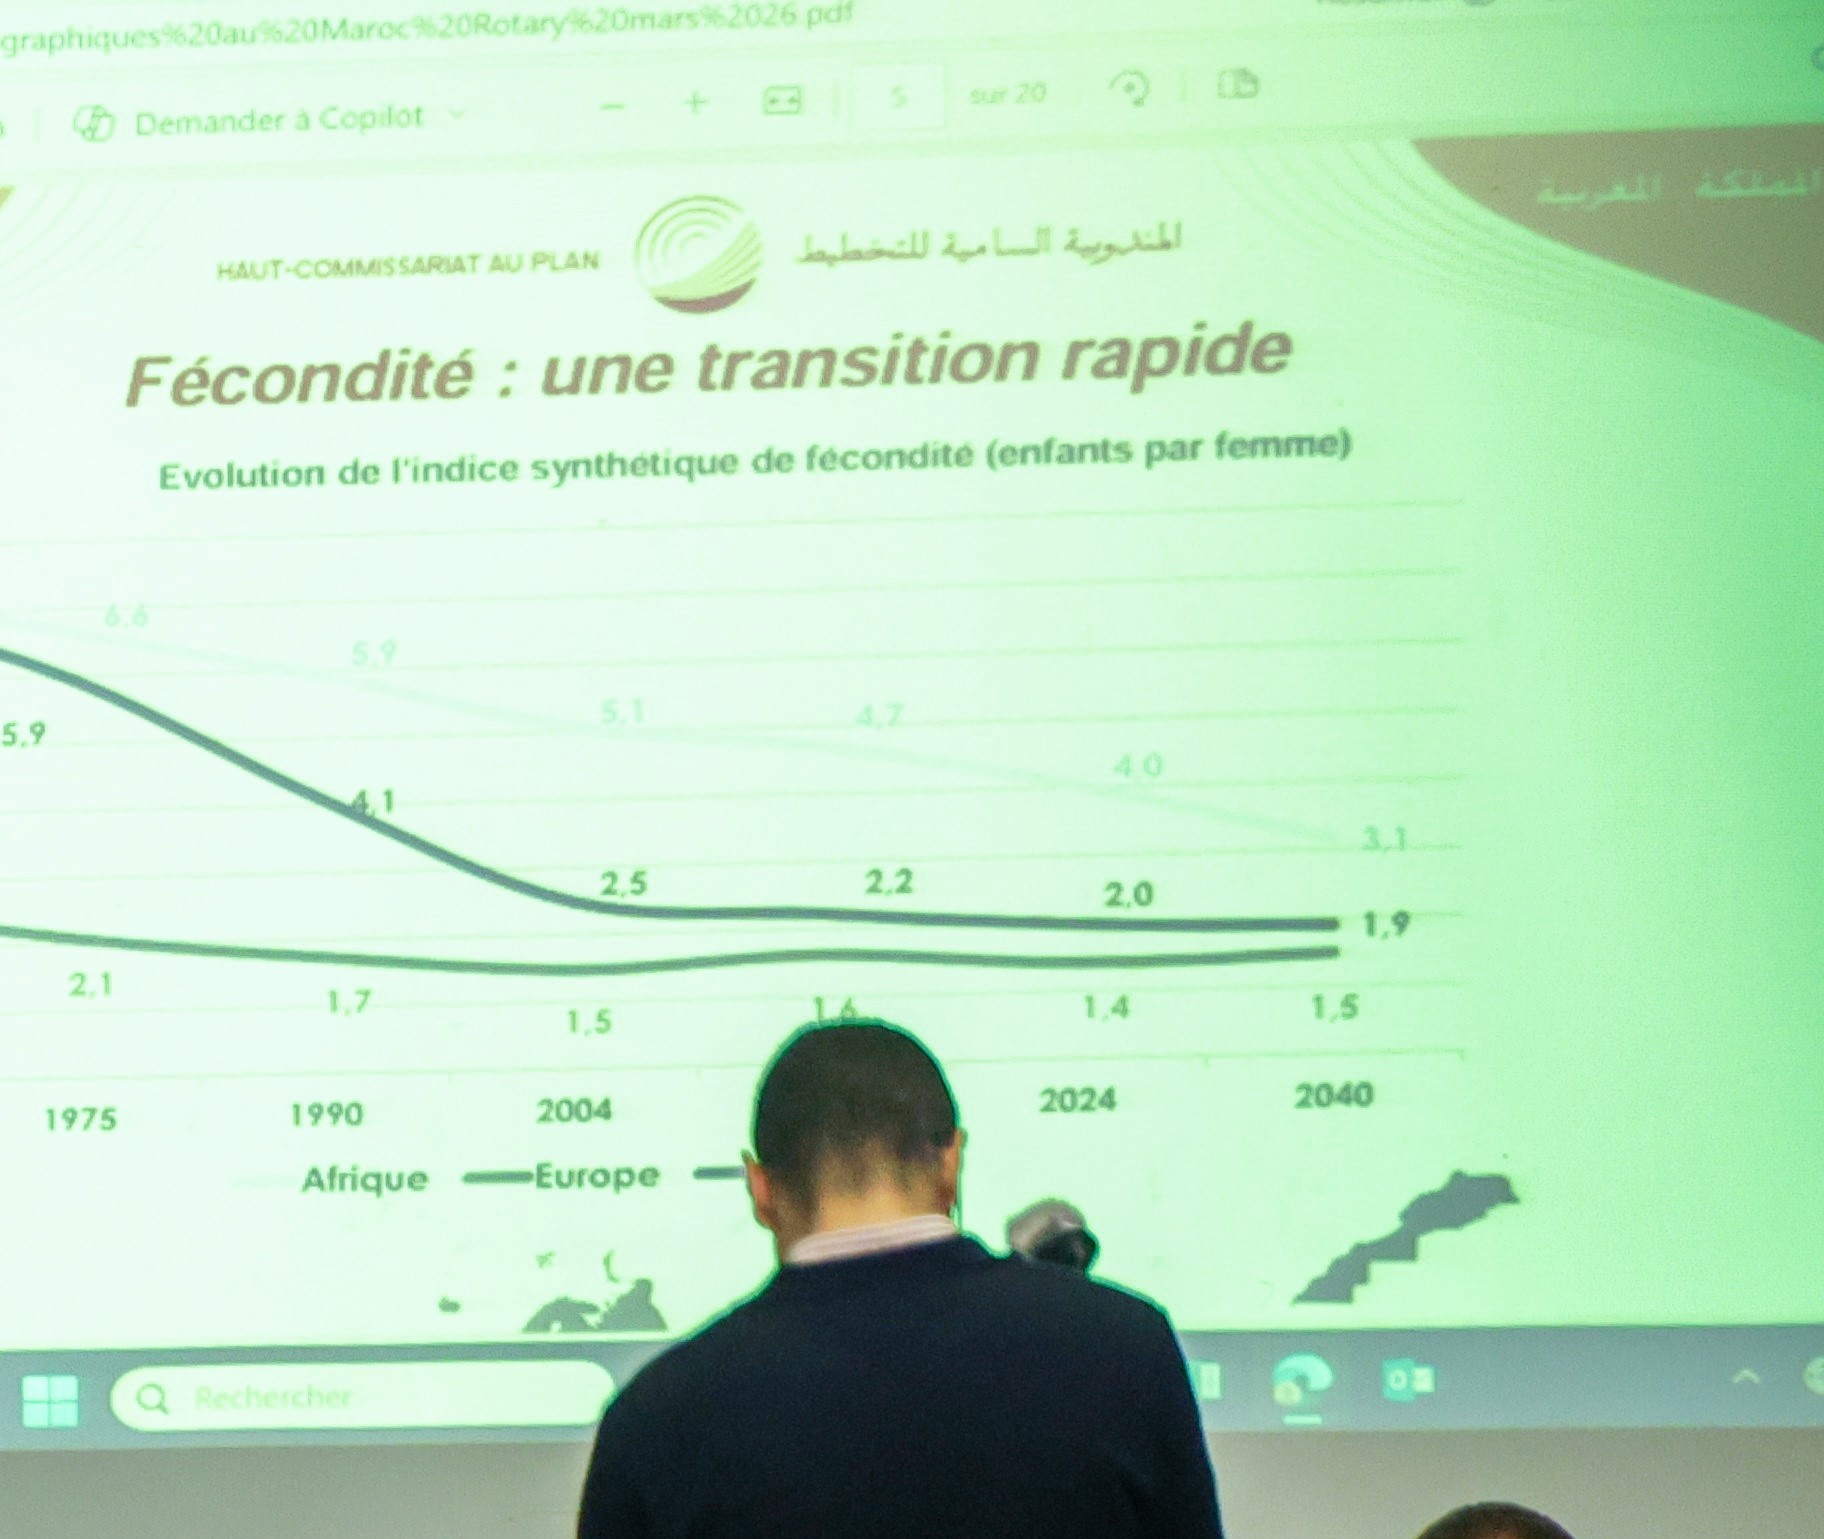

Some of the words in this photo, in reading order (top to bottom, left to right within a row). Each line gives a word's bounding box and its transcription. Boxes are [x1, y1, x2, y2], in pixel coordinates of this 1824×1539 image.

[970, 86, 1007, 104] sur
[1016, 82, 1047, 102] 20
[136, 107, 283, 138] Demander
[296, 106, 313, 131] à
[319, 103, 425, 136] Copilot
[217, 253, 483, 281] HAUT-COMMISSARIAT
[488, 253, 523, 274] AU
[531, 250, 601, 272] PLAN
[124, 347, 476, 408] Fécondité
[540, 350, 676, 397] une
[697, 329, 1042, 392] transition
[1060, 318, 1294, 396] rapide
[159, 458, 326, 492] Evolution
[336, 457, 382, 487] de
[391, 455, 521, 485] l'indice
[530, 445, 740, 490] synthétique
[751, 445, 796, 475] de
[806, 440, 974, 473] fécondité
[986, 430, 1134, 472] (enfants
[1144, 437, 1204, 471] par
[1214, 427, 1353, 461] femme)
[45, 1105, 119, 1133] 1975
[290, 1099, 366, 1128] 1990
[536, 1096, 614, 1125] 2004
[1039, 1085, 1118, 1114] 2024
[1294, 1080, 1376, 1111] 2040
[301, 1164, 430, 1199] Afrique
[534, 1160, 662, 1195] Europe
[194, 1384, 354, 1409] Rechercher
